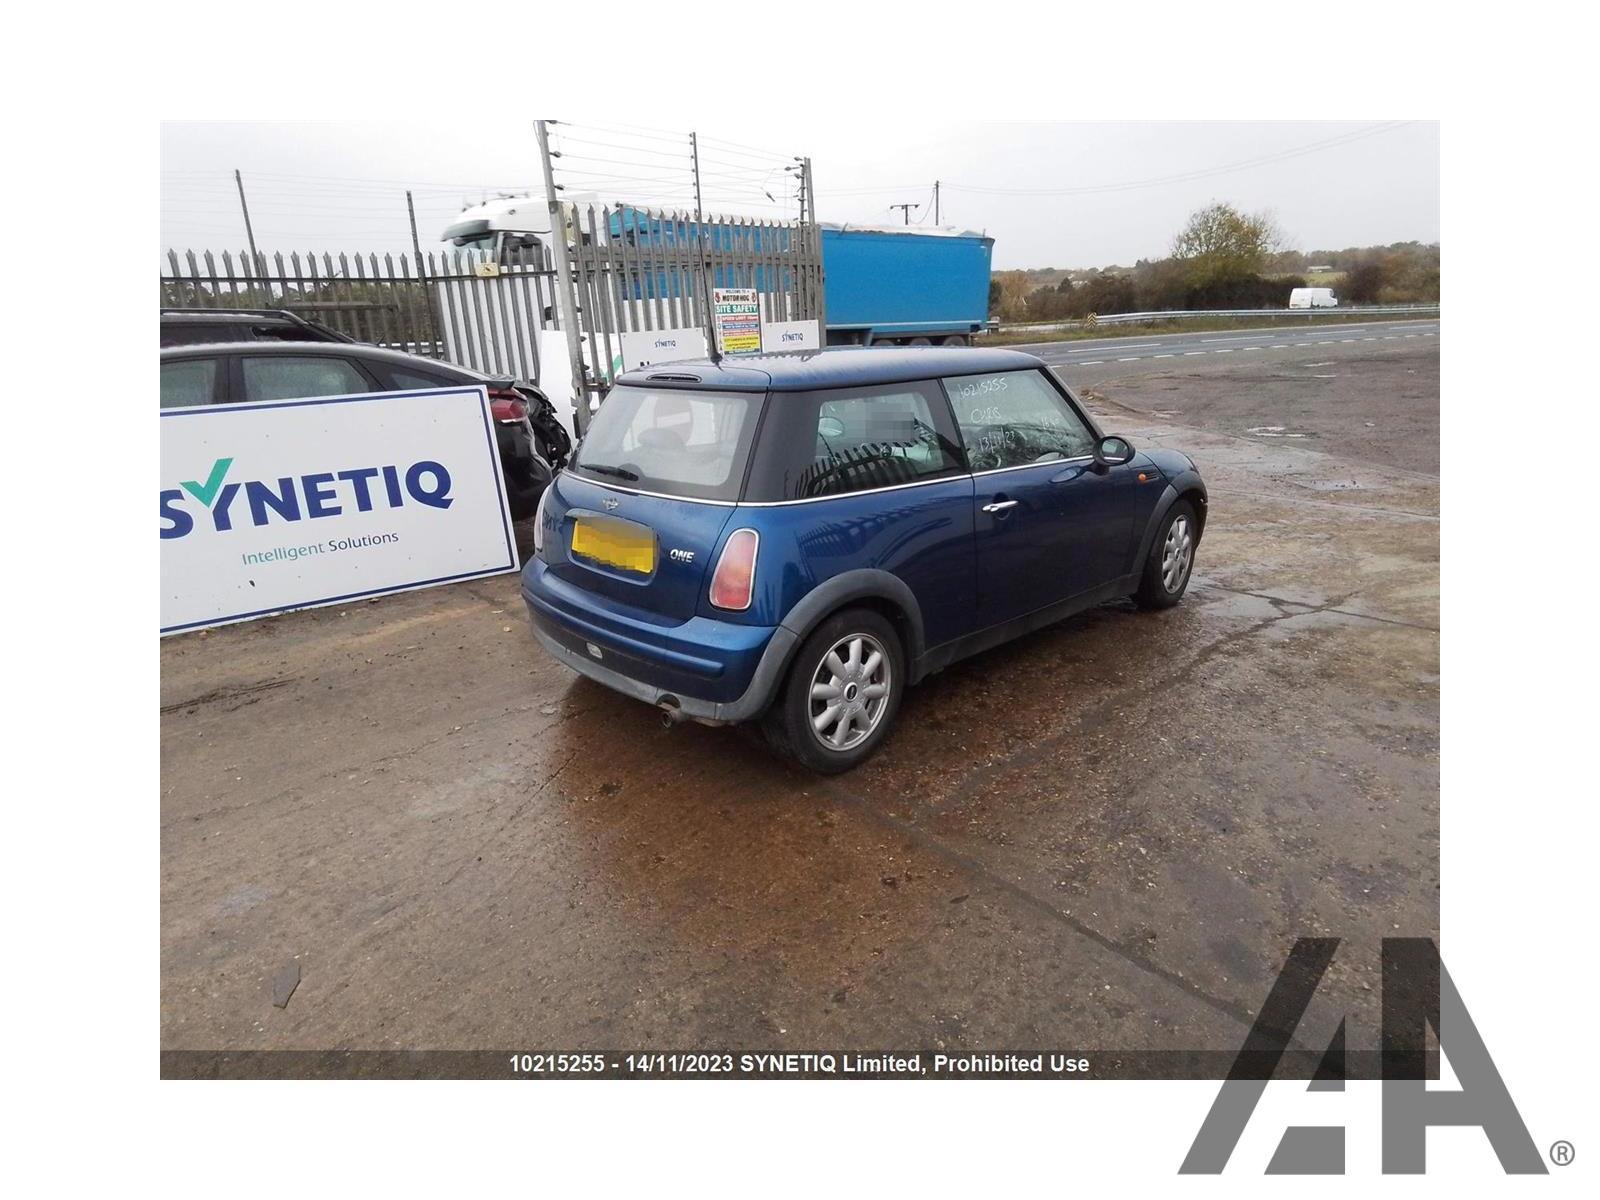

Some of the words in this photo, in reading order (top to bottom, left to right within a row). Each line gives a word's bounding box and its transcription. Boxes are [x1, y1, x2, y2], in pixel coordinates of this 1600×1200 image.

[716, 304, 731, 314] SITE
[732, 304, 757, 313] SAFETY
[654, 338, 676, 348] SYNETIQ
[782, 331, 804, 342] SYNETIQ
[959, 377, 1008, 399] 10215255
[160, 457, 454, 539] SYNETIQ
[242, 543, 325, 565] Intelligent
[328, 531, 399, 552] Solutions
[669, 549, 695, 563] ONE
